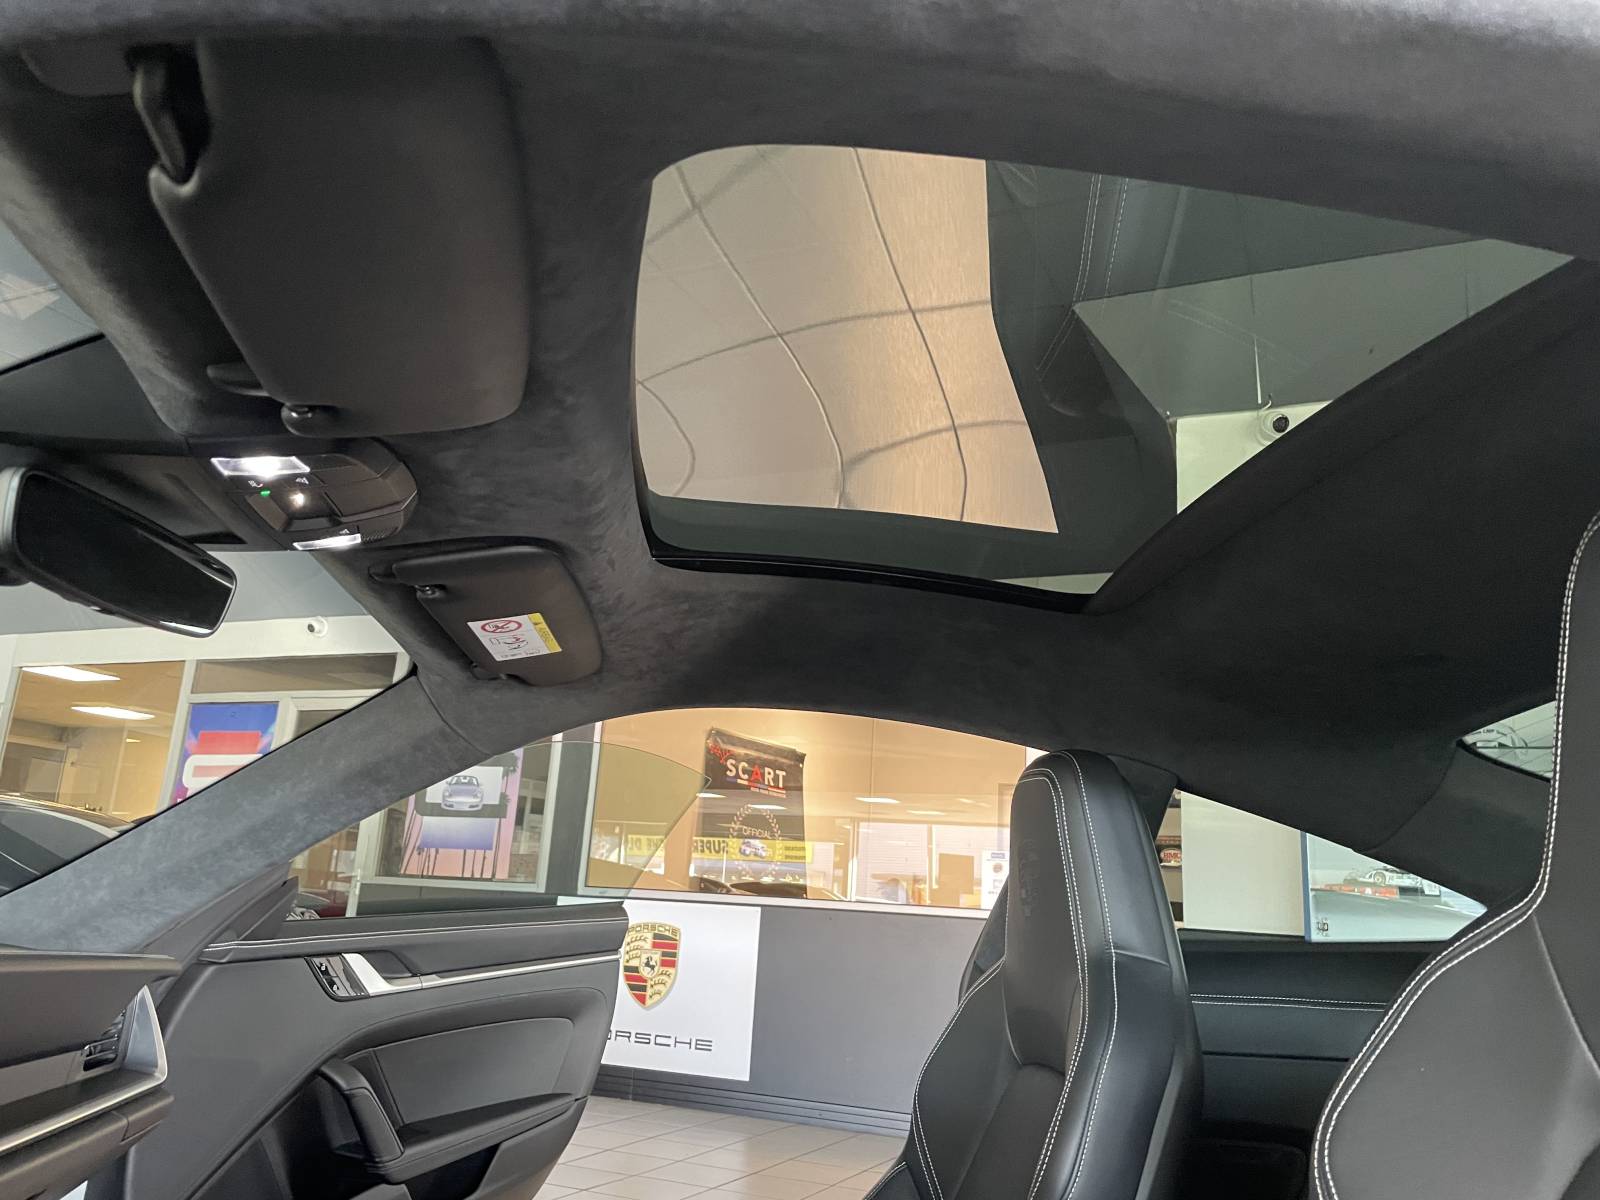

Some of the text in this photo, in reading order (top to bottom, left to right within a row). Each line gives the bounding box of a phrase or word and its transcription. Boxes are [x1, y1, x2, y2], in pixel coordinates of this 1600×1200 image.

[726, 759, 786, 788] SCART
[742, 828, 772, 840] OFFICIAL
[628, 924, 678, 938] PORSCHE
[608, 1029, 712, 1052] RSCHE
